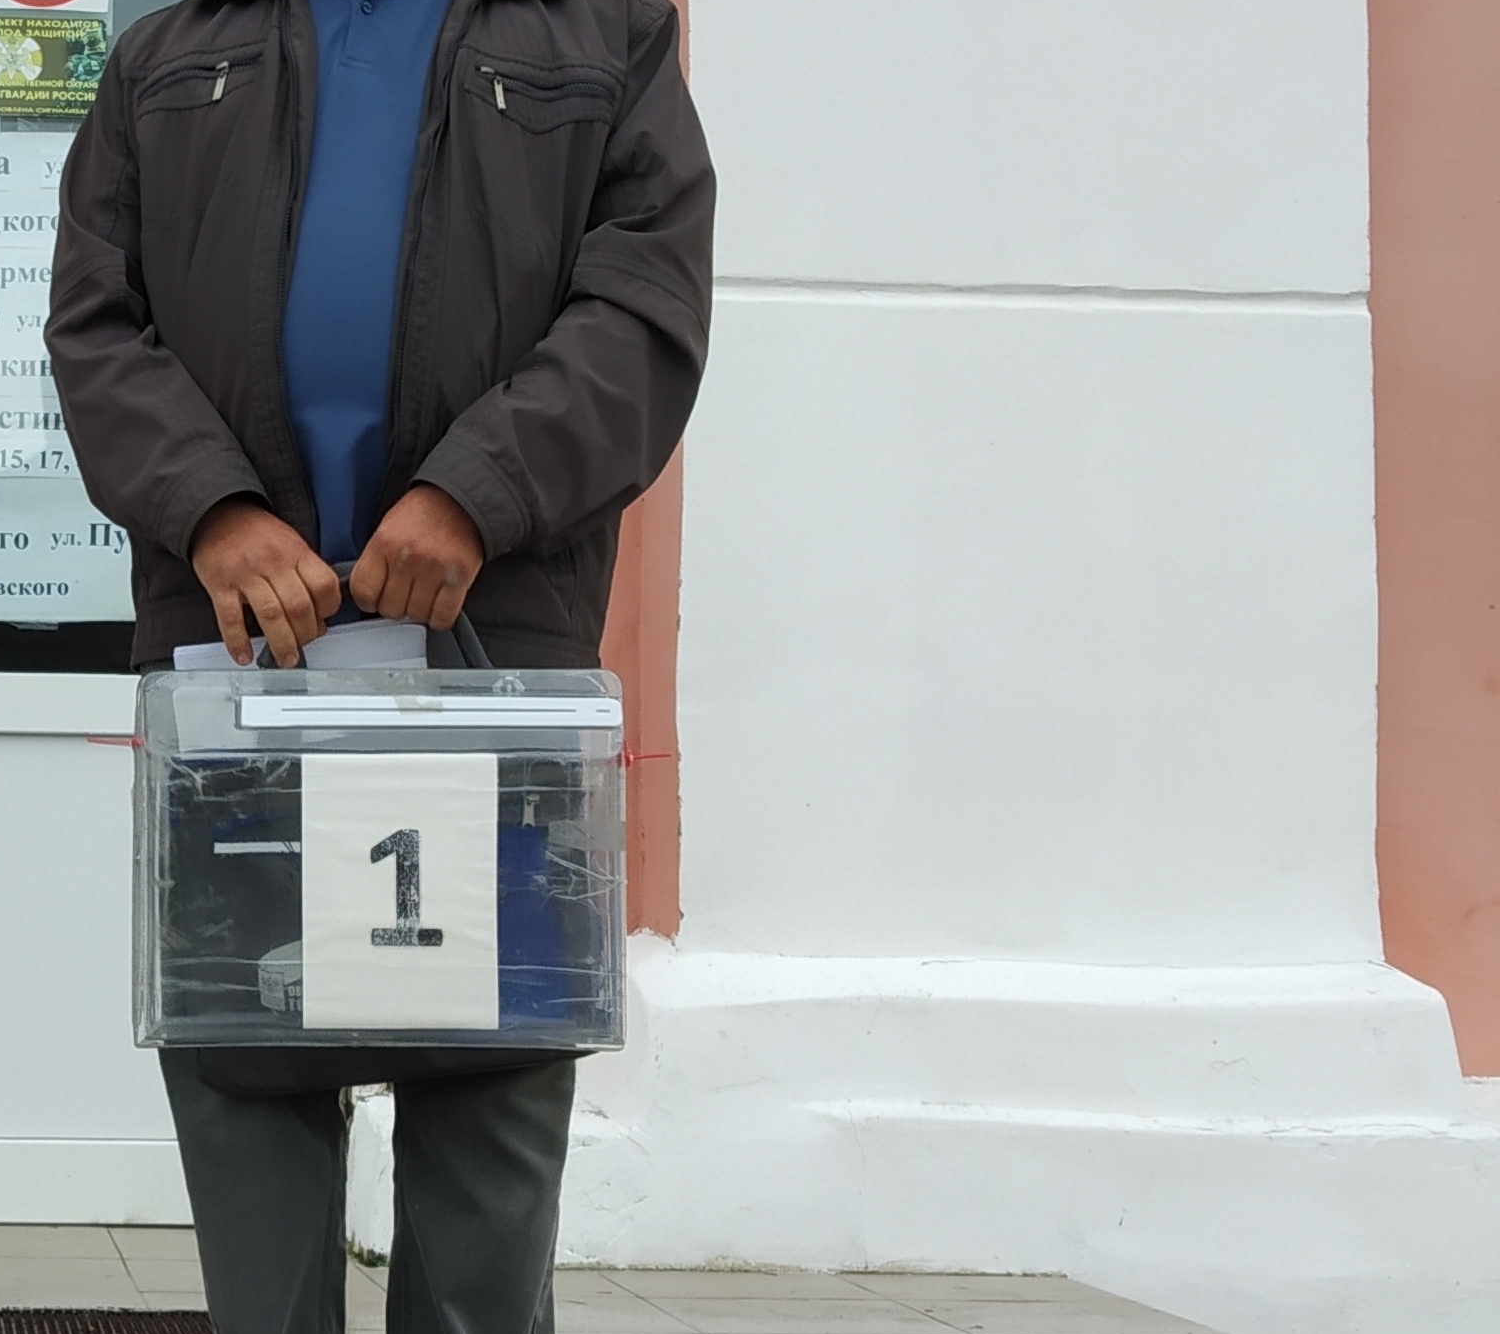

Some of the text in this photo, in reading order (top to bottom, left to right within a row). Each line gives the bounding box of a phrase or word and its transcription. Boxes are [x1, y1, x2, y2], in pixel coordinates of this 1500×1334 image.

[26, 19, 99, 29] НАХОДИТСЯ
[25, 29, 85, 38] ЗАЩИТОЙ
[0, 449, 30, 471] 15,
[39, 450, 70, 474] 17,
[50, 532, 82, 550] ул.
[369, 828, 443, 947] 1
